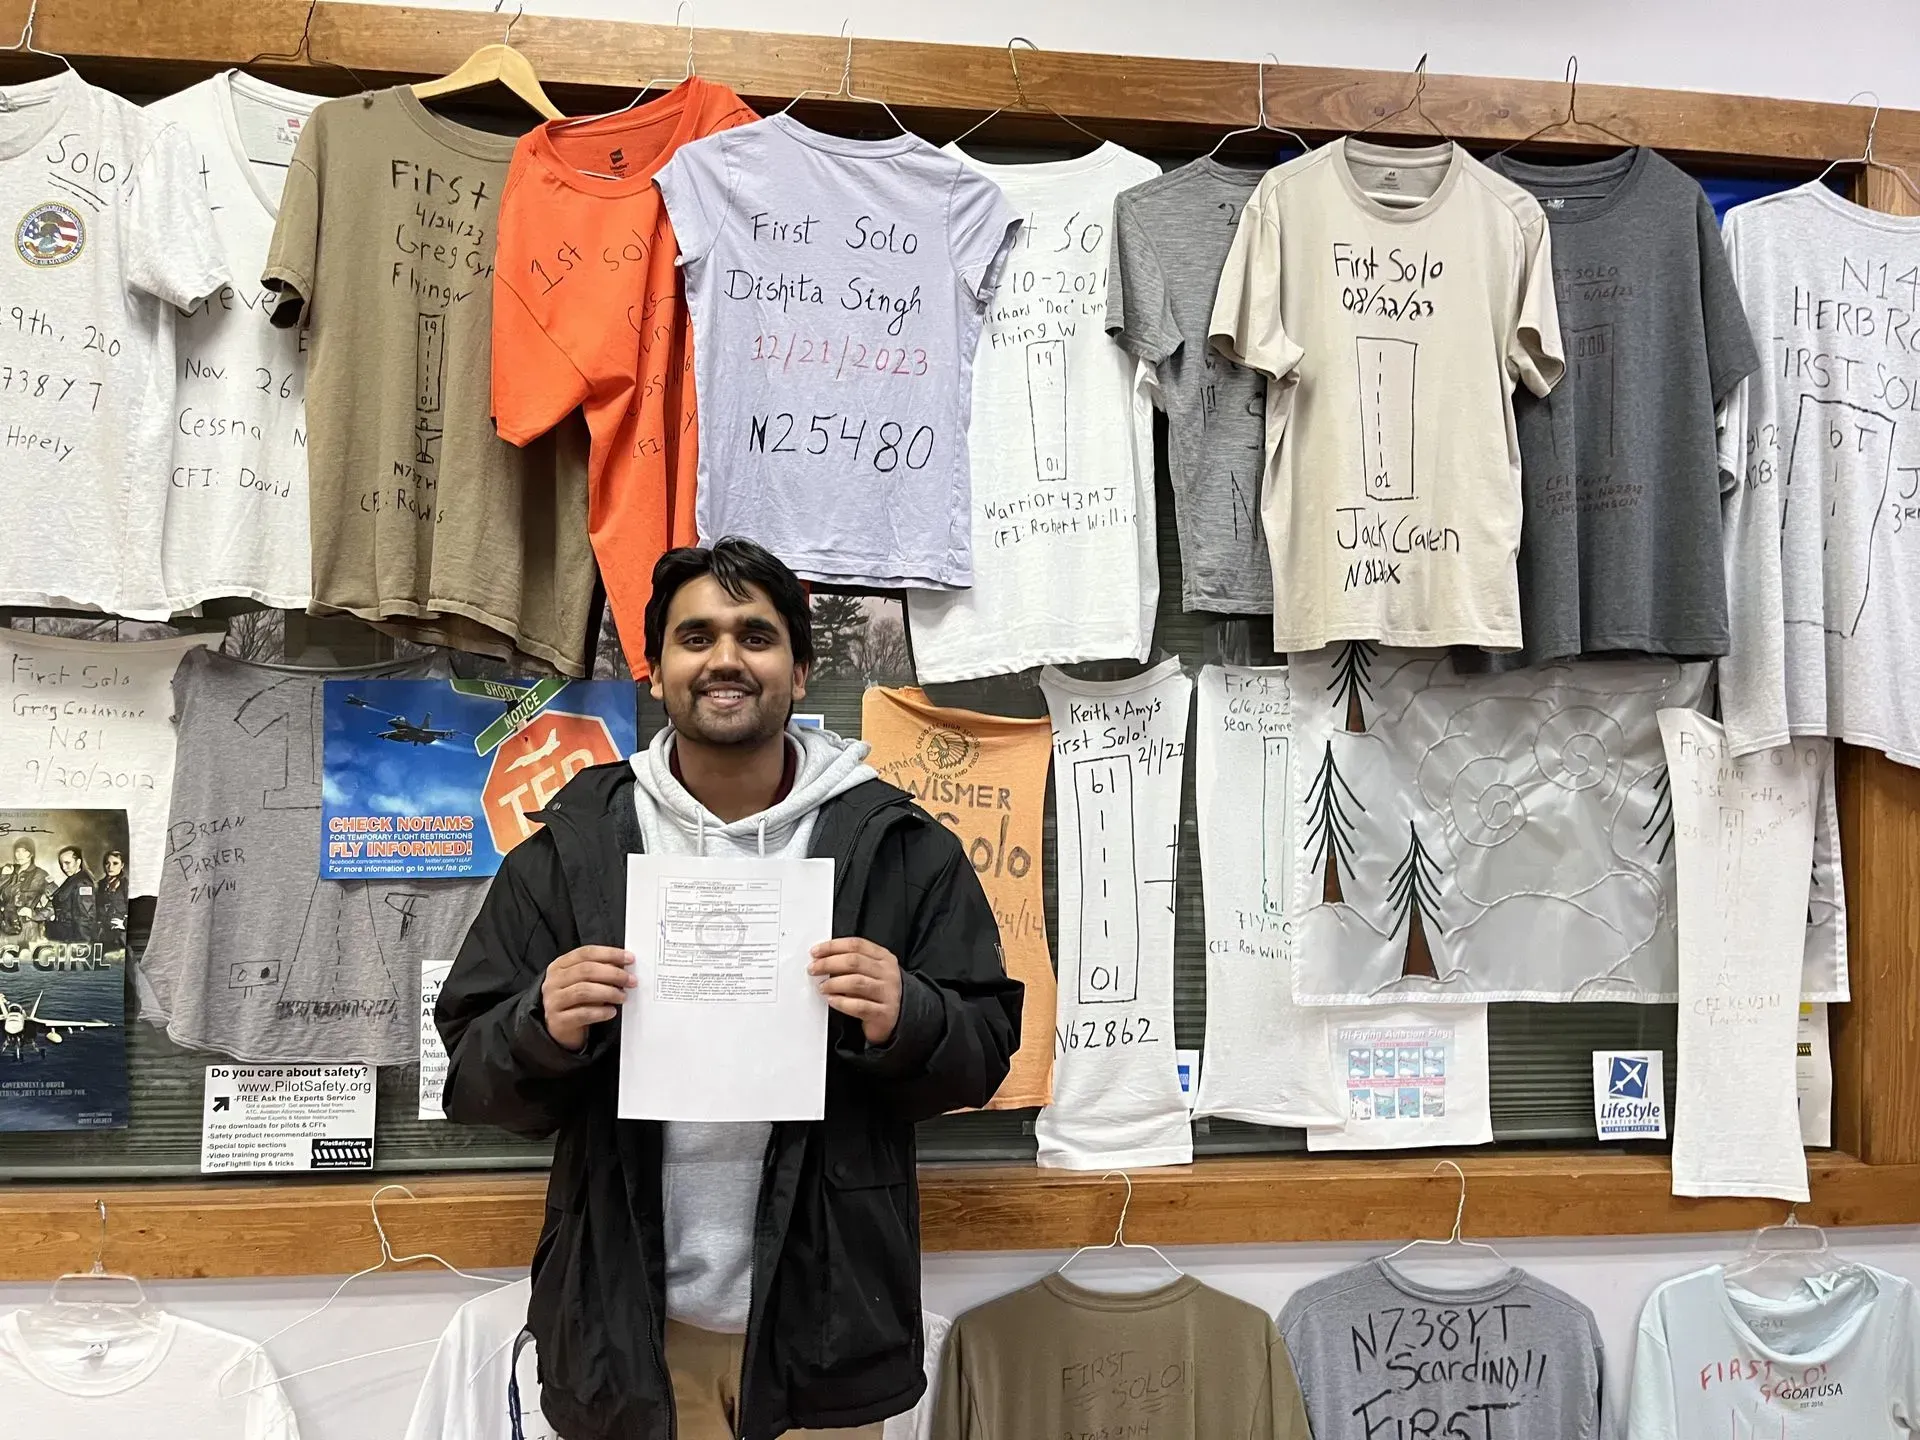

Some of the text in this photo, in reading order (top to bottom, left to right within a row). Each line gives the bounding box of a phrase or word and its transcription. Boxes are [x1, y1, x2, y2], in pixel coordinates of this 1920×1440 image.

[391, 159, 493, 210] First
[396, 223, 458, 269] Greg
[750, 212, 918, 254] First Solo
[1333, 243, 1443, 288] First Solo
[1576, 266, 1618, 280] SOLO
[724, 269, 921, 335] Dishita Singh
[1342, 284, 1434, 321] 08/22/23
[1794, 286, 1875, 336] HERB
[1058, 321, 1077, 337] W
[185, 357, 229, 381] Nov.
[751, 333, 928, 380] 12/21/2023
[179, 407, 262, 441] Cessna
[749, 413, 934, 472] N25480
[239, 467, 290, 498] David
[1375, 472, 1391, 488] 01
[984, 492, 1055, 520] Warrior
[1030, 517, 1080, 536] Robert
[1336, 508, 1388, 552] Jack
[12, 654, 130, 688] First Solo
[484, 683, 517, 701] SHORT
[504, 692, 541, 730] NOTICE
[1070, 697, 1162, 725] Keith Amy's
[1224, 715, 1254, 732] Sean
[49, 726, 102, 750] N81
[1102, 721, 1148, 749] Solo!
[931, 751, 980, 780] TRACK AND FIELD
[1138, 737, 1185, 775] 2/1/22
[26, 756, 154, 792] 9/20/2012
[164, 816, 246, 860] BRIAN
[329, 816, 474, 832] CHECK NOTAMS
[329, 832, 473, 841] FOR TEMPORARY FLIGHT RESTRICTIONS
[329, 840, 473, 858] FLY INFORMED!
[172, 847, 245, 882] PARKER
[329, 865, 341, 873] For
[364, 865, 404, 873] information
[32, 943, 111, 972] GIRL
[1090, 966, 1119, 991] 01
[422, 1036, 437, 1048] top
[211, 1067, 368, 1079] Do you care about safety?
[237, 1080, 371, 1093] www.PilotSafety.org
[1600, 1101, 1660, 1122] LifeStyle
[1352, 1304, 1531, 1373] N738YT
[1062, 1350, 1135, 1396] FIRST
[1700, 1358, 1774, 1392] FIRST
